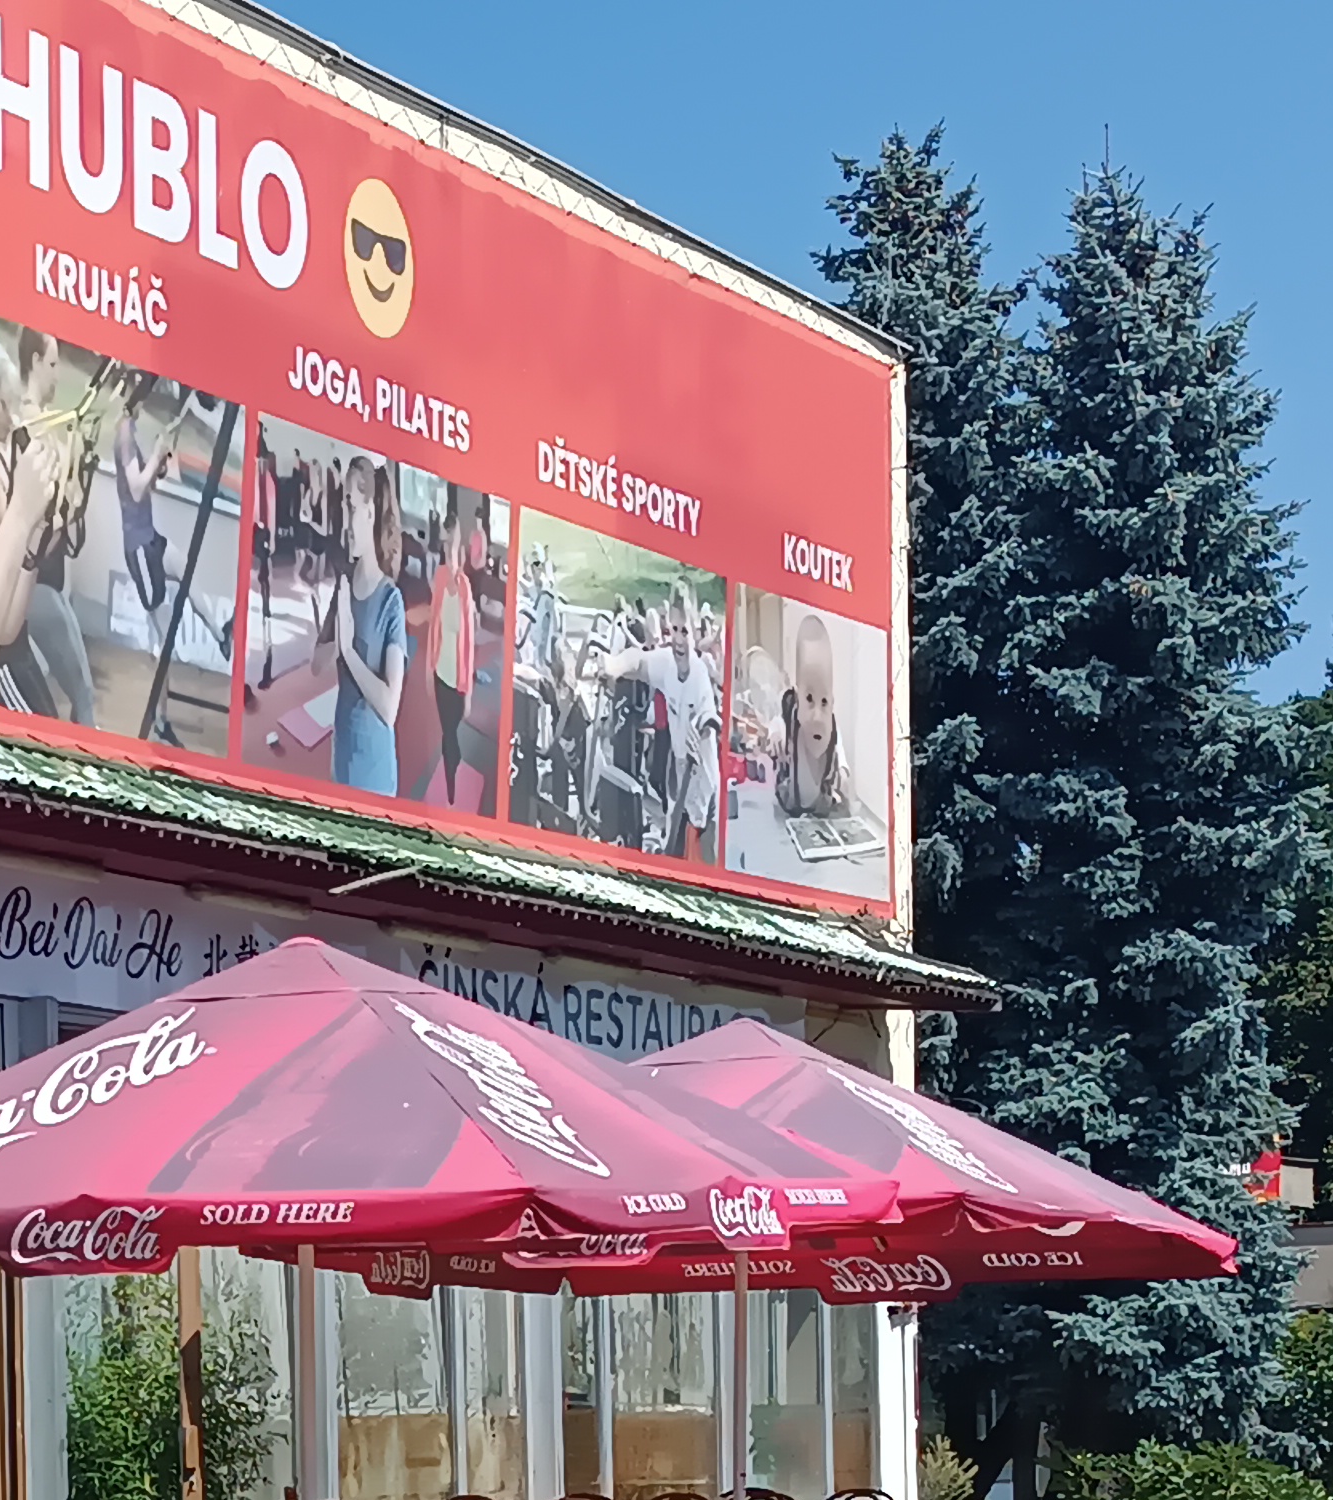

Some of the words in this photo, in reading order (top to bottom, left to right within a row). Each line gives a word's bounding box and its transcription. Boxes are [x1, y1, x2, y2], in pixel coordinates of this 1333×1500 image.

[34, 243, 169, 337] KRUHÁČ
[288, 346, 370, 424] JOGA,
[375, 379, 471, 453] PILATES
[537, 436, 618, 509] DĚTSKÉ
[621, 472, 701, 537] SPORTY
[782, 531, 854, 593] KOUTEK
[63, 896, 123, 970] Dai
[125, 908, 183, 983] He
[10, 1206, 162, 1264] Coca-Cola
[199, 1204, 269, 1226] SOLD
[275, 1202, 355, 1224] HERE
